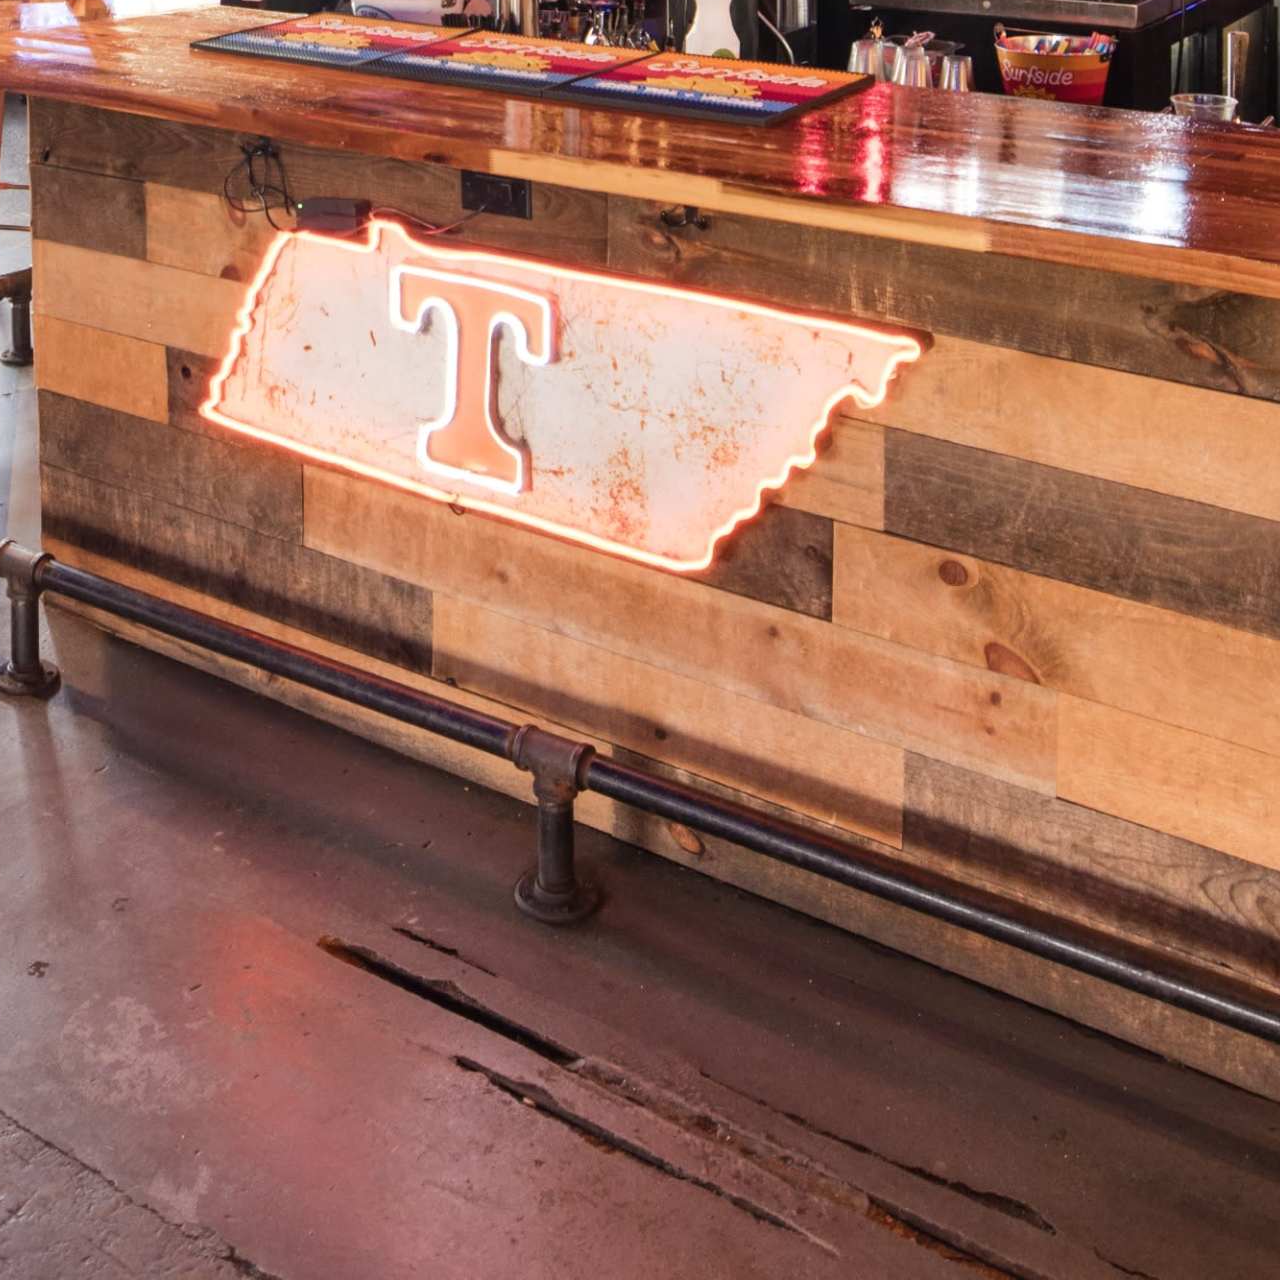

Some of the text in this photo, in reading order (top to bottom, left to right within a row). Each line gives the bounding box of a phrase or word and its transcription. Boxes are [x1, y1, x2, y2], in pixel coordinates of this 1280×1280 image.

[293, 17, 441, 44] Surfside
[457, 37, 618, 65] Surfside
[647, 60, 828, 88] Surfside
[1002, 59, 1073, 86] Surfside
[389, 264, 558, 497] T
